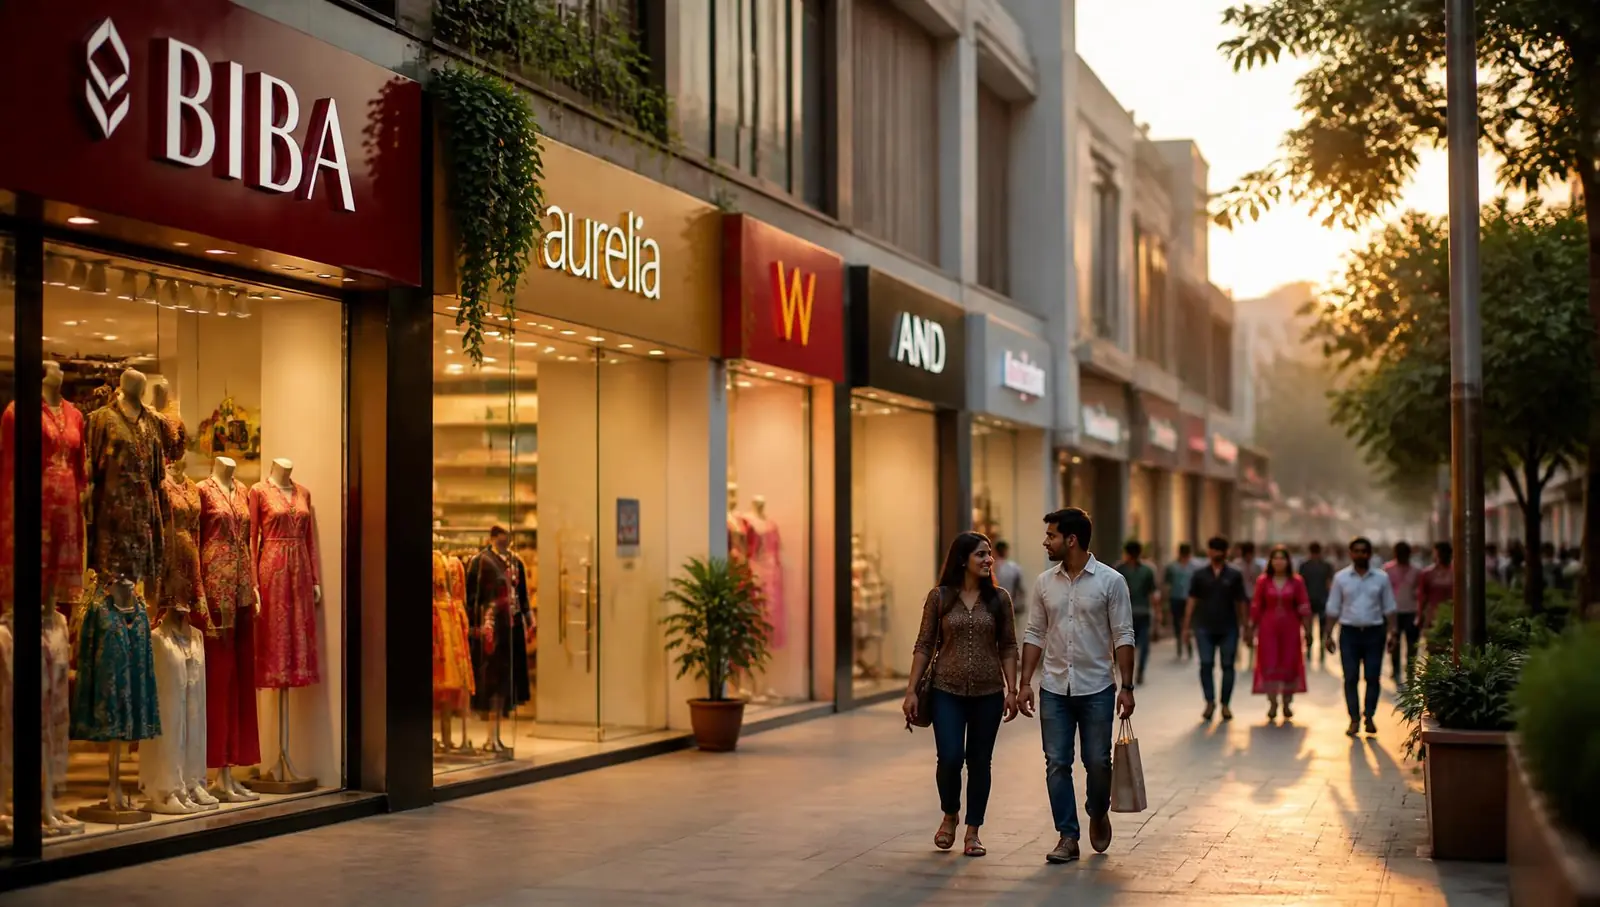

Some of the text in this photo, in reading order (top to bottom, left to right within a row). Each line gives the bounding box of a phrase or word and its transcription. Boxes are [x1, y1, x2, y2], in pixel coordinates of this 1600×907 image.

[166, 38, 355, 212] BIBA
[544, 205, 661, 299] aurelia
[776, 261, 815, 346] W
[897, 312, 946, 373] AND
